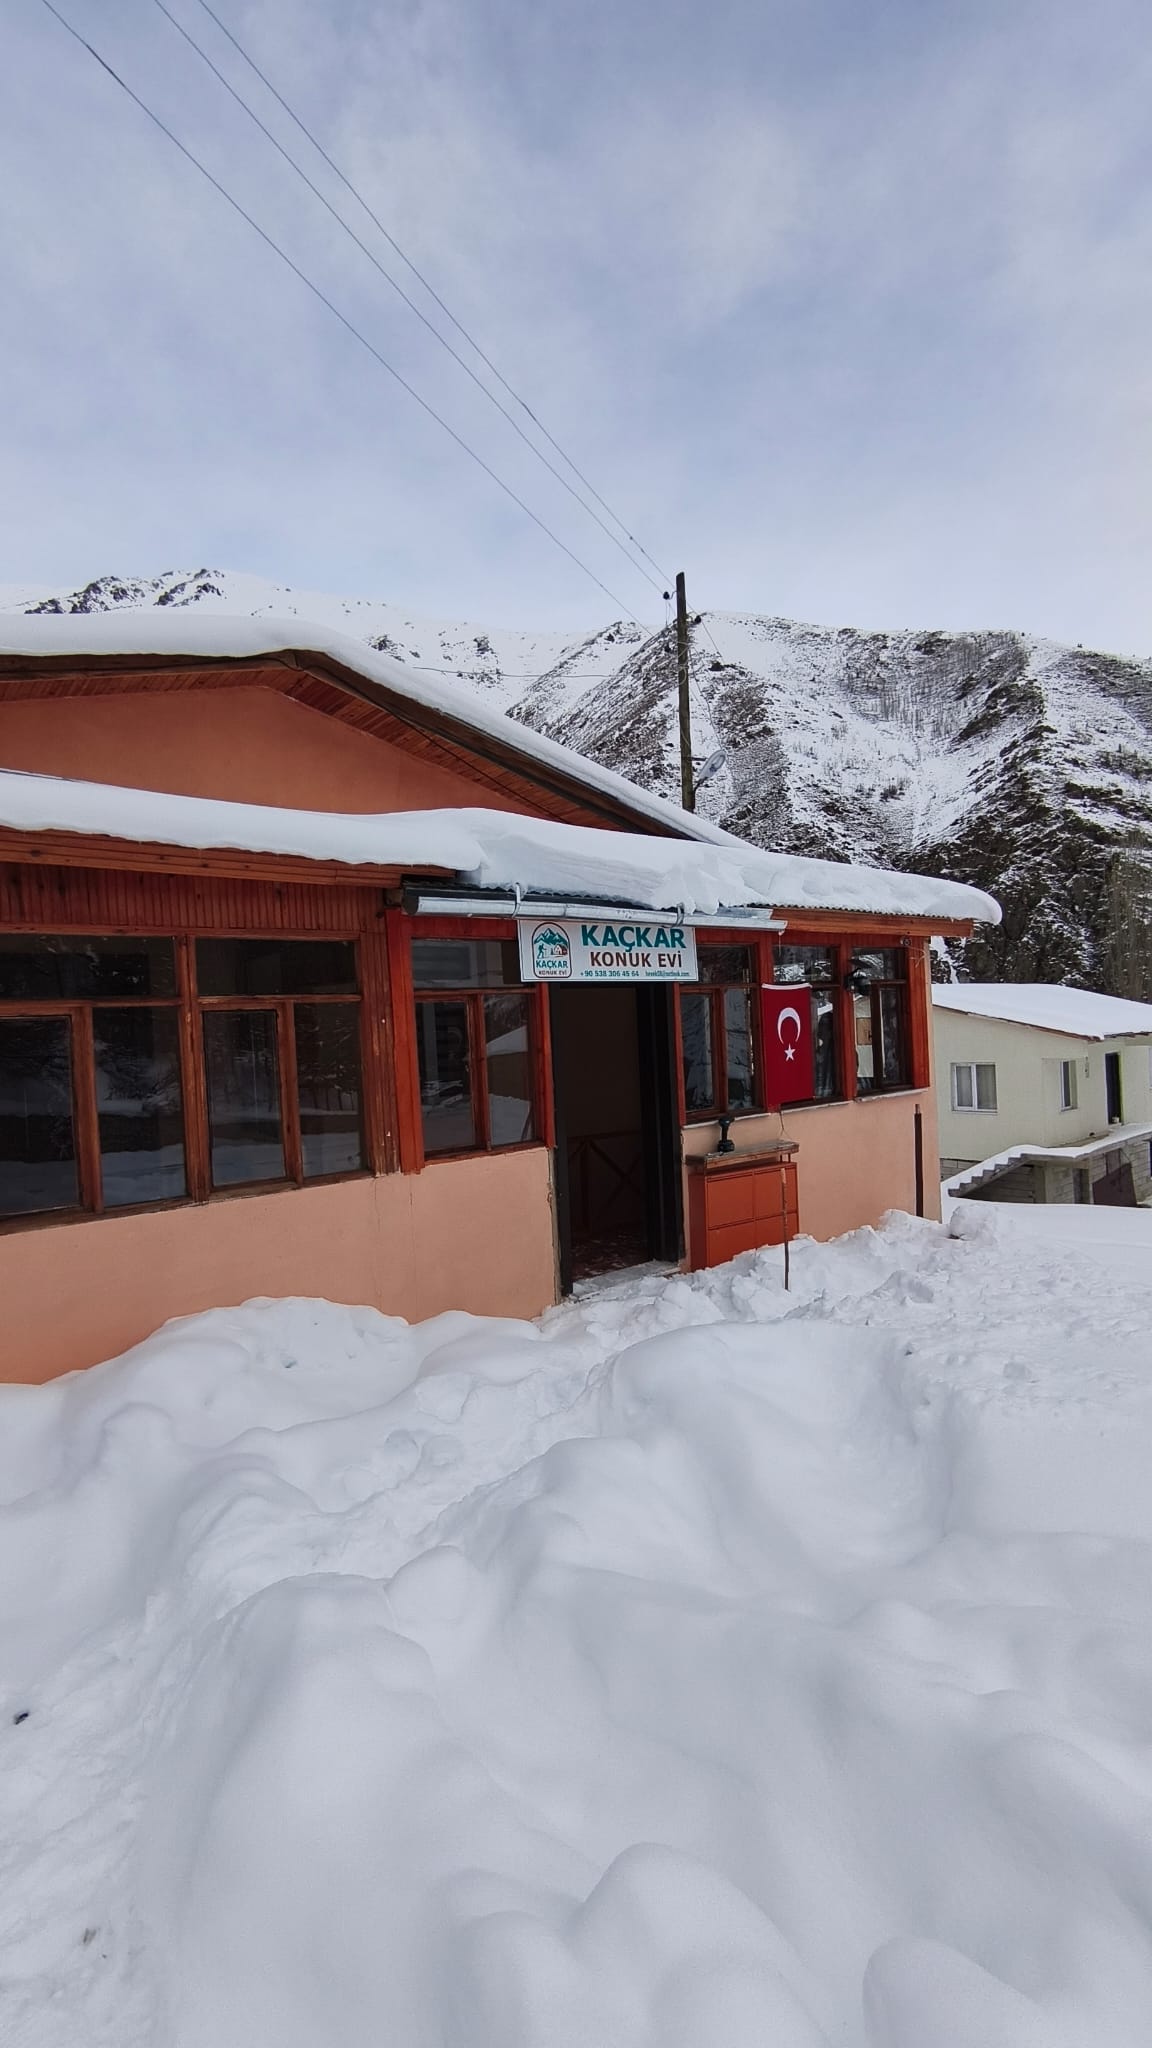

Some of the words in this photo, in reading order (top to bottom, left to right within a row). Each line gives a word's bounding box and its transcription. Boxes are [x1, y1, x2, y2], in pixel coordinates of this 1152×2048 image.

[581, 924, 687, 952] KAÇKAR
[535, 960, 569, 970] KAÇKAR
[590, 951, 653, 968] KONUK
[658, 950, 682, 968] EVİ
